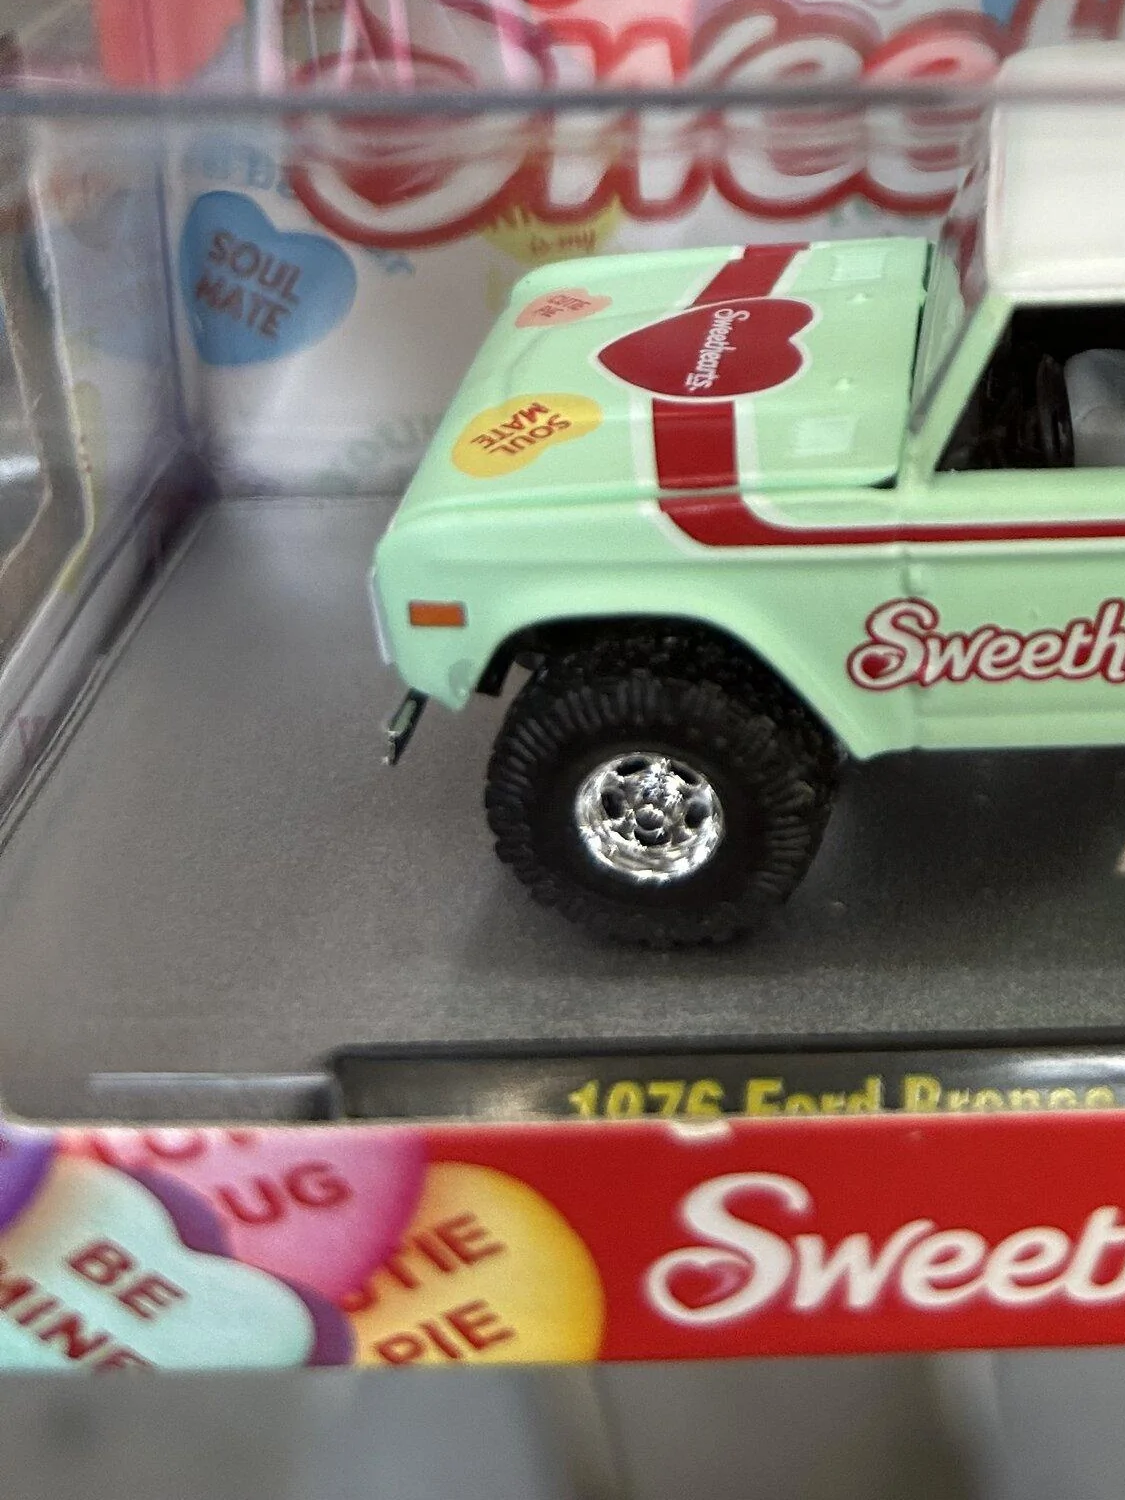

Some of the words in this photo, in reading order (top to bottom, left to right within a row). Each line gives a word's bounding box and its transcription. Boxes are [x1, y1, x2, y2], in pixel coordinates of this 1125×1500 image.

[205, 228, 303, 304] SOUL
[193, 273, 292, 340] MATE
[692, 307, 751, 389] Sweethearts
[470, 401, 550, 448] MATE
[489, 412, 573, 456] SOUL
[217, 1161, 352, 1226] UG
[69, 1241, 188, 1320] BE
